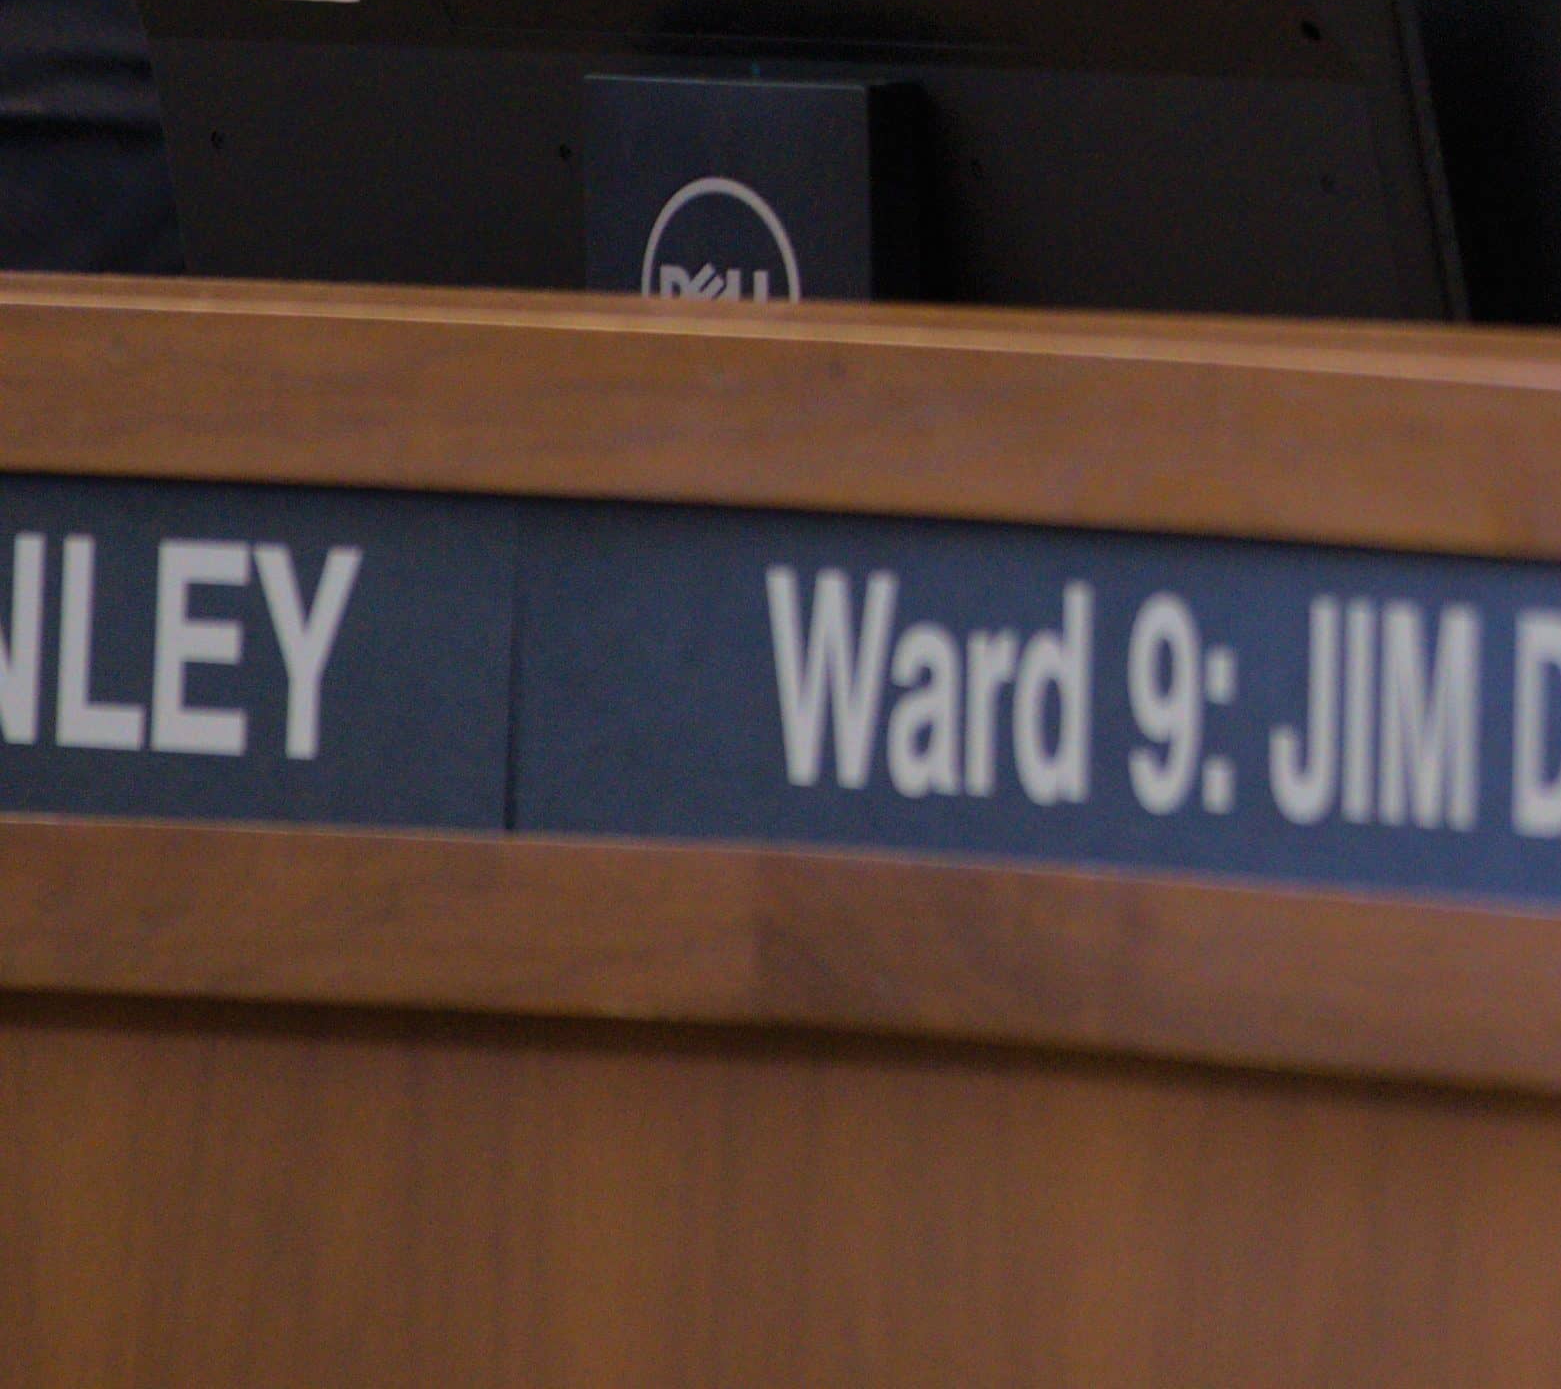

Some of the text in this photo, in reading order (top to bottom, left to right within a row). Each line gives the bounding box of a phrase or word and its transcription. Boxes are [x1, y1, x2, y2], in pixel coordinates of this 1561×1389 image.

[765, 566, 1093, 805] Ward
[1127, 593, 1236, 814] 9:
[1268, 597, 1481, 830] JIM
